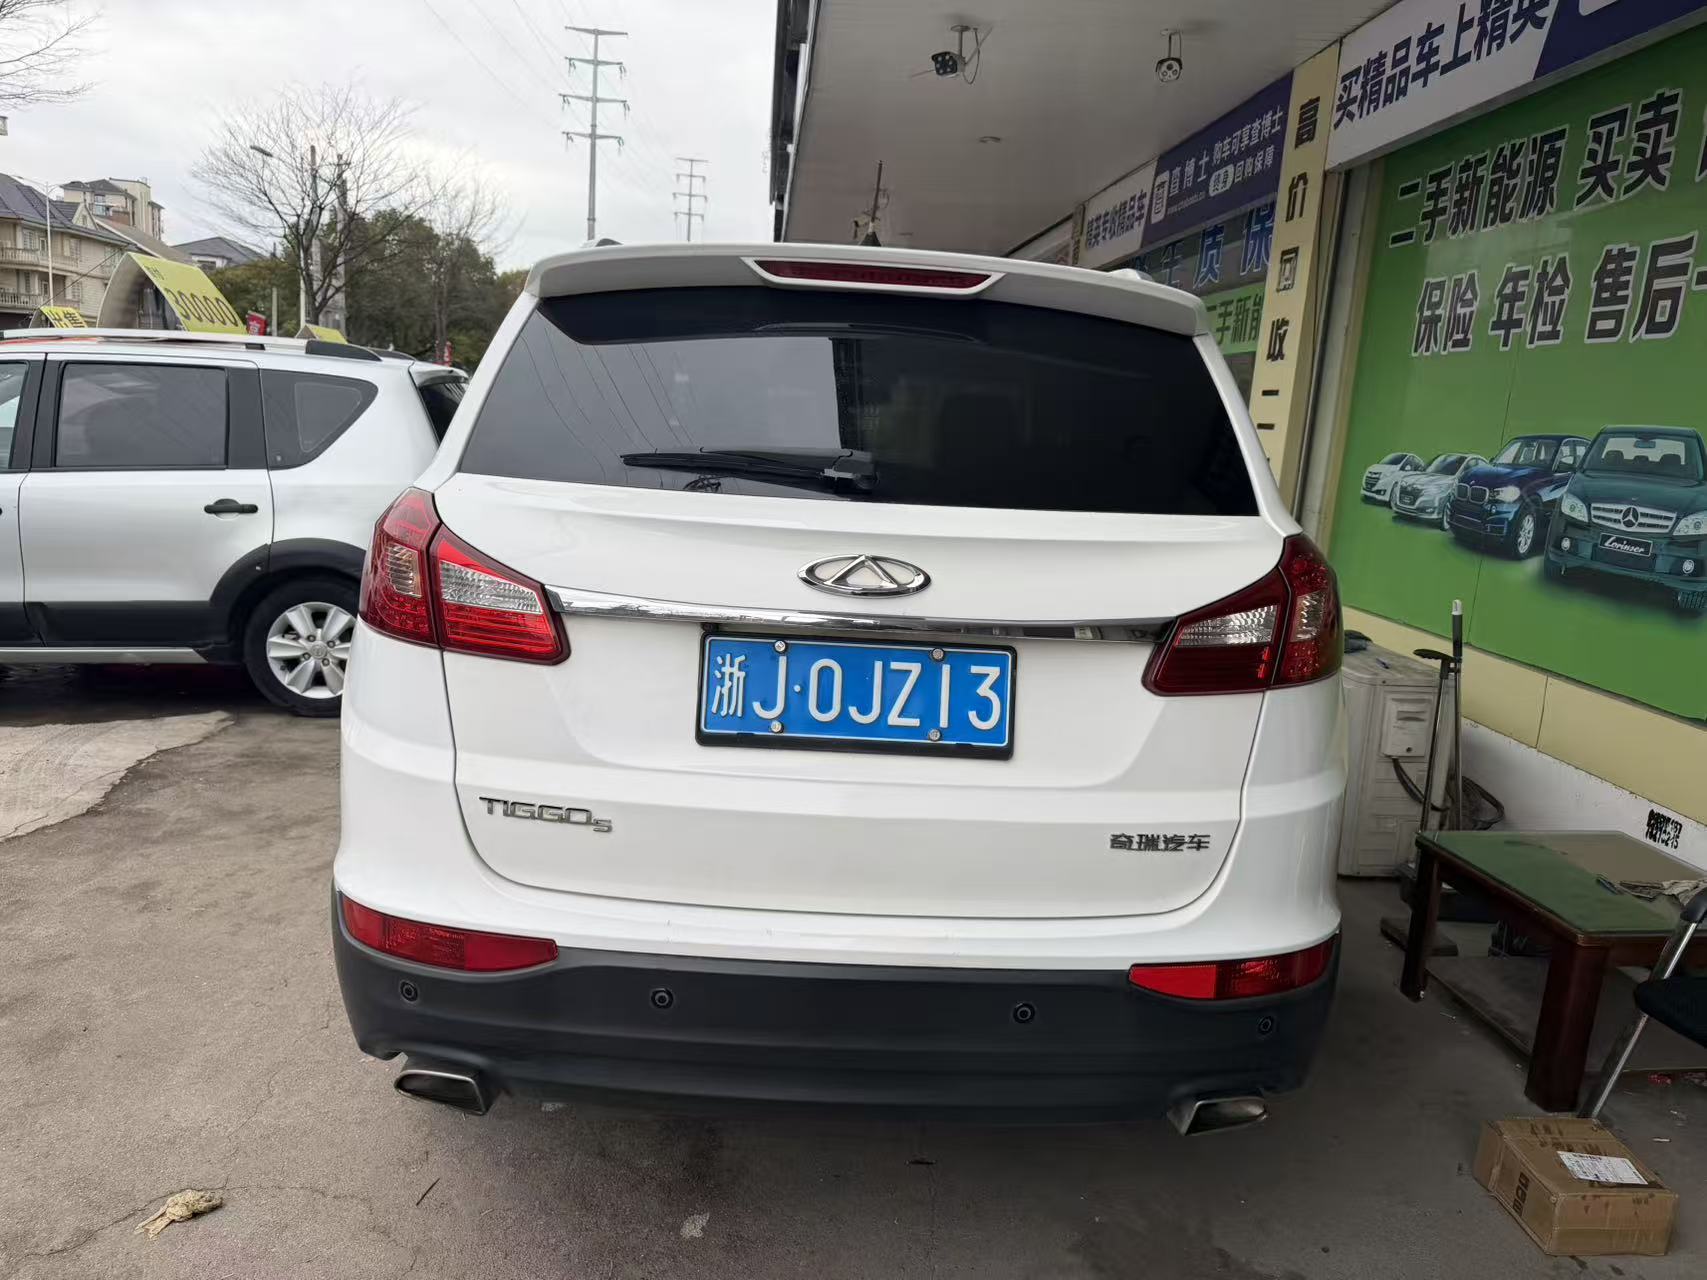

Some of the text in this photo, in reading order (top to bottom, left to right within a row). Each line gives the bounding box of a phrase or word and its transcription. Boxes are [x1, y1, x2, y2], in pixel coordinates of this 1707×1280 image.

[1332, 0, 1552, 131] 买精品车上精英
[1212, 105, 1284, 166] 购车可享查博士
[1168, 150, 1210, 197] 查博士
[1389, 124, 1568, 248] 二手新能源
[1574, 87, 1684, 207] 买卖
[163, 287, 239, 328] 30000
[1411, 271, 1480, 357] 保险
[1489, 252, 1573, 351] 年检
[1109, 833, 1211, 852] 奇瑞汽车
